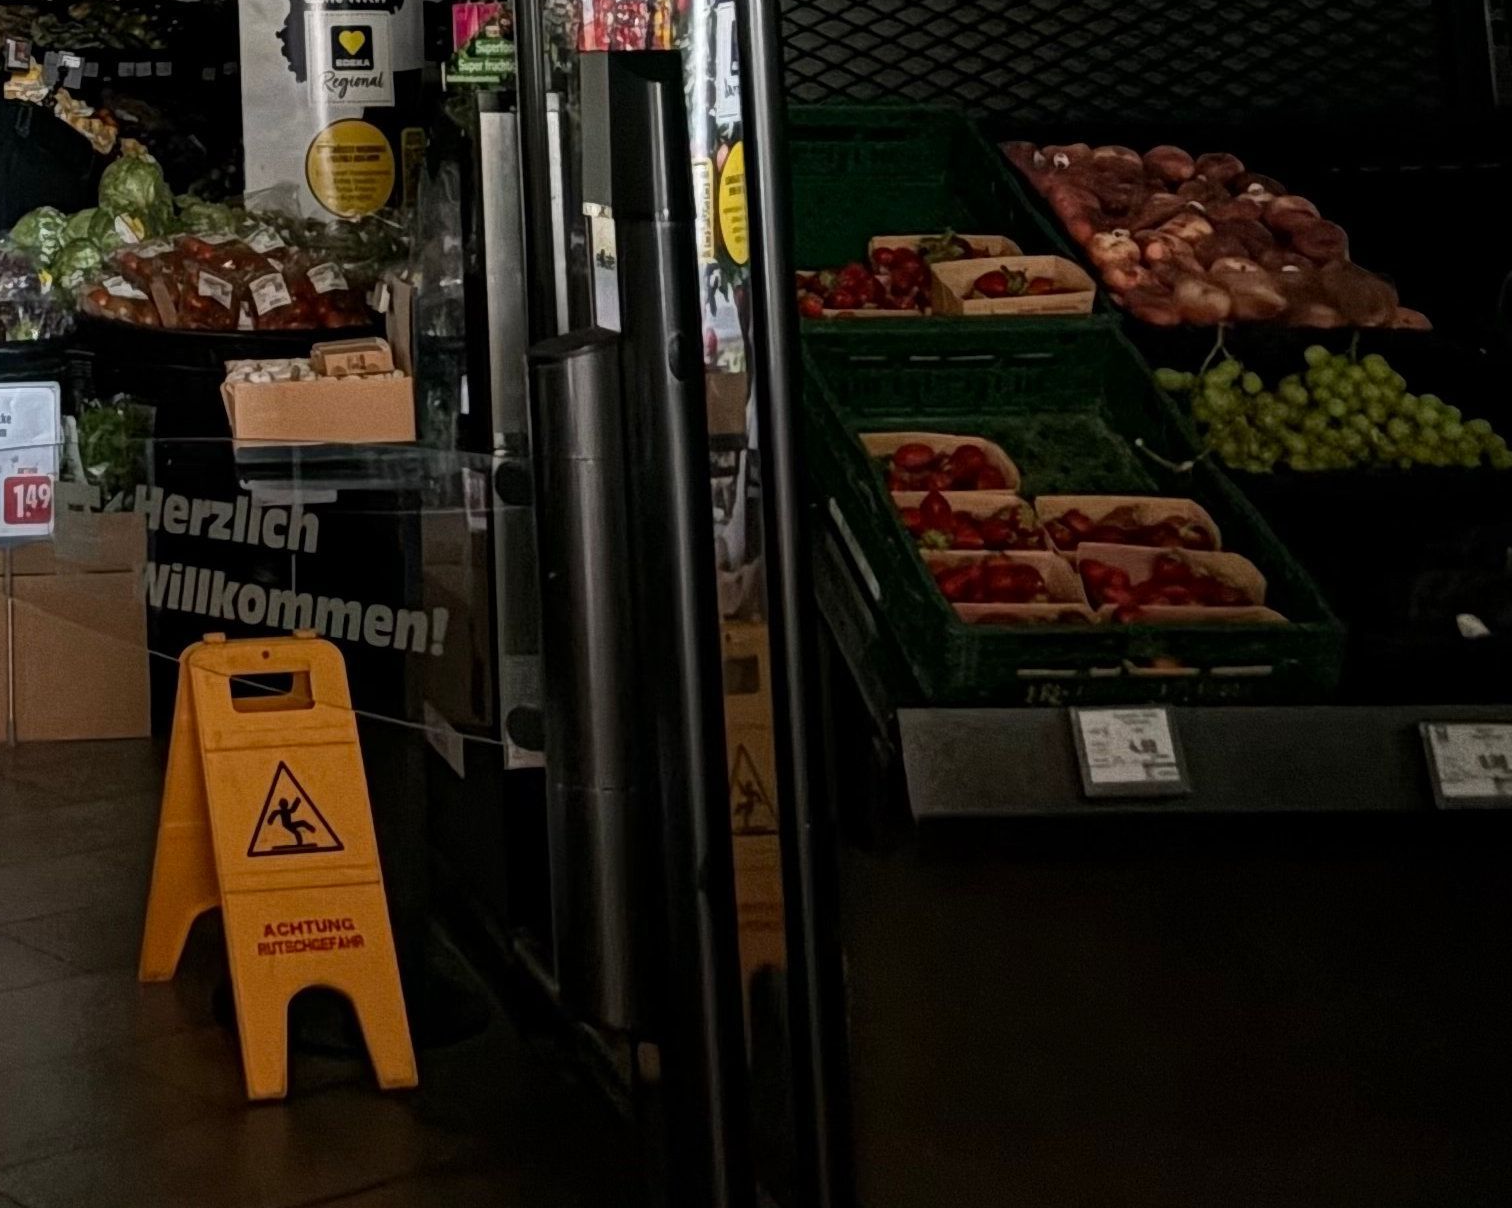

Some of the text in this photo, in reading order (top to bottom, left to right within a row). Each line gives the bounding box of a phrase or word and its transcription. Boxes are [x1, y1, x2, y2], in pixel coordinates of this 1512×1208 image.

[322, 70, 384, 99] Regional
[13, 483, 52, 518] 1.49
[133, 483, 321, 554] Herzlich
[264, 918, 355, 938] ACHTUNG
[257, 935, 365, 956] RUTSCHGEFAHR
